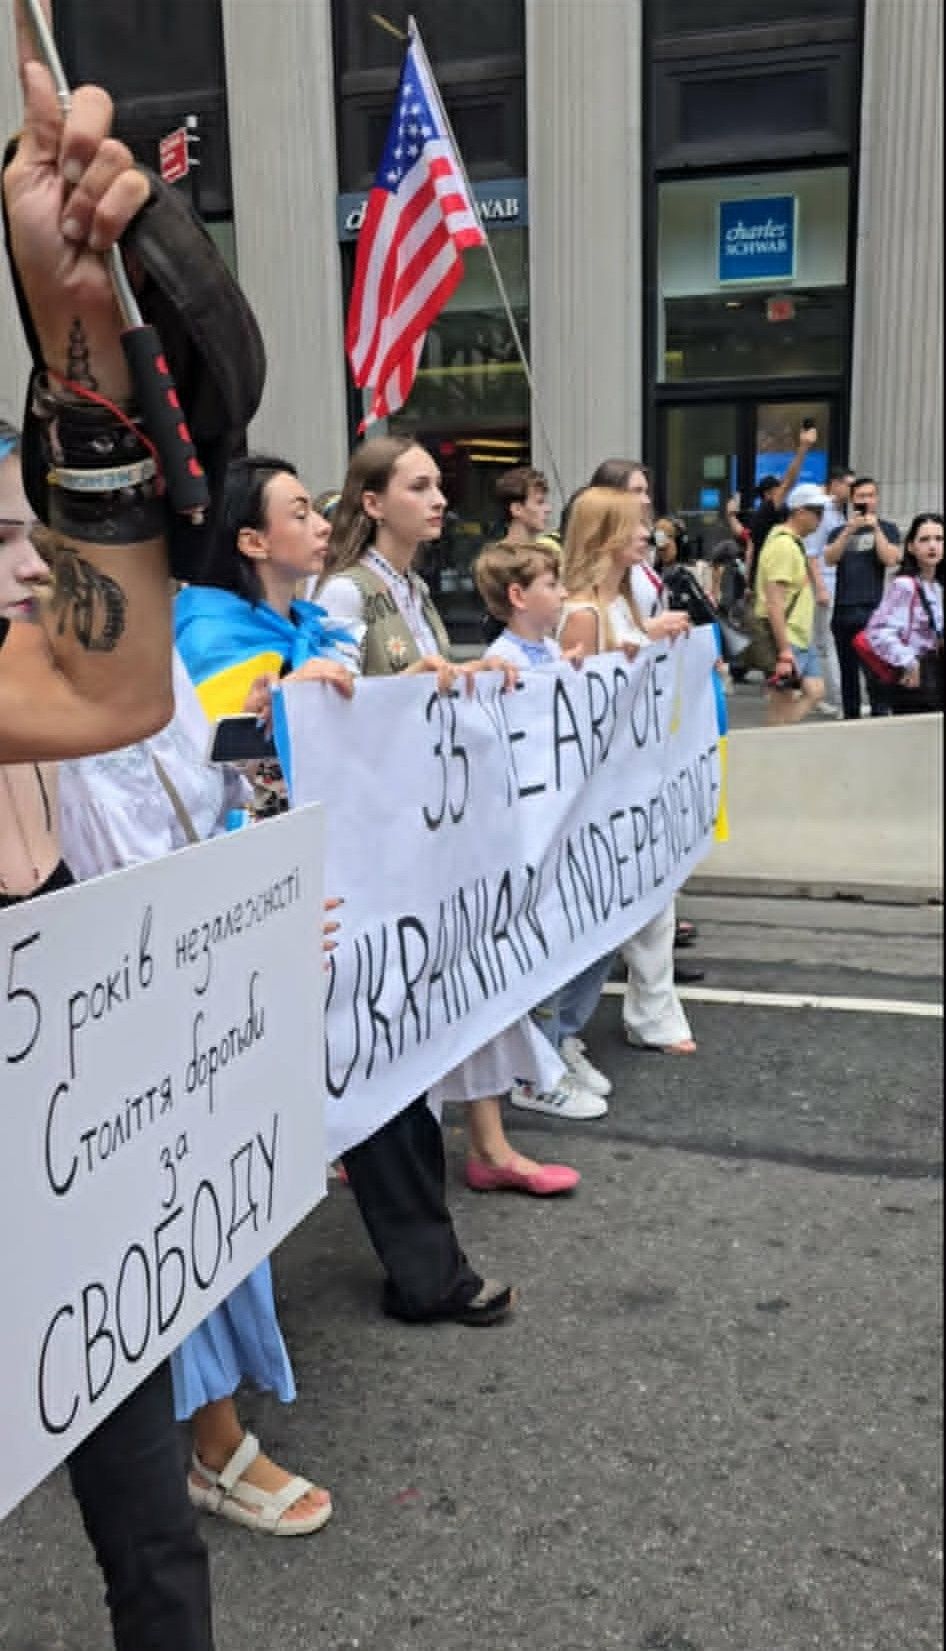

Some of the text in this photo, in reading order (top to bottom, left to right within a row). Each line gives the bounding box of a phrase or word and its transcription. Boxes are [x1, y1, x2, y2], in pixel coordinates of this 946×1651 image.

[726, 239, 787, 256] SCHWAB
[422, 687, 469, 831] 35
[630, 654, 668, 749] OF
[68, 904, 153, 1080] років
[175, 866, 299, 996] незалежності
[324, 860, 551, 1098] UKRAINIAN
[45, 970, 265, 1196] Століття боротьби
[160, 1131, 188, 1210] за
[38, 1112, 279, 1435] СВОБОДУ
